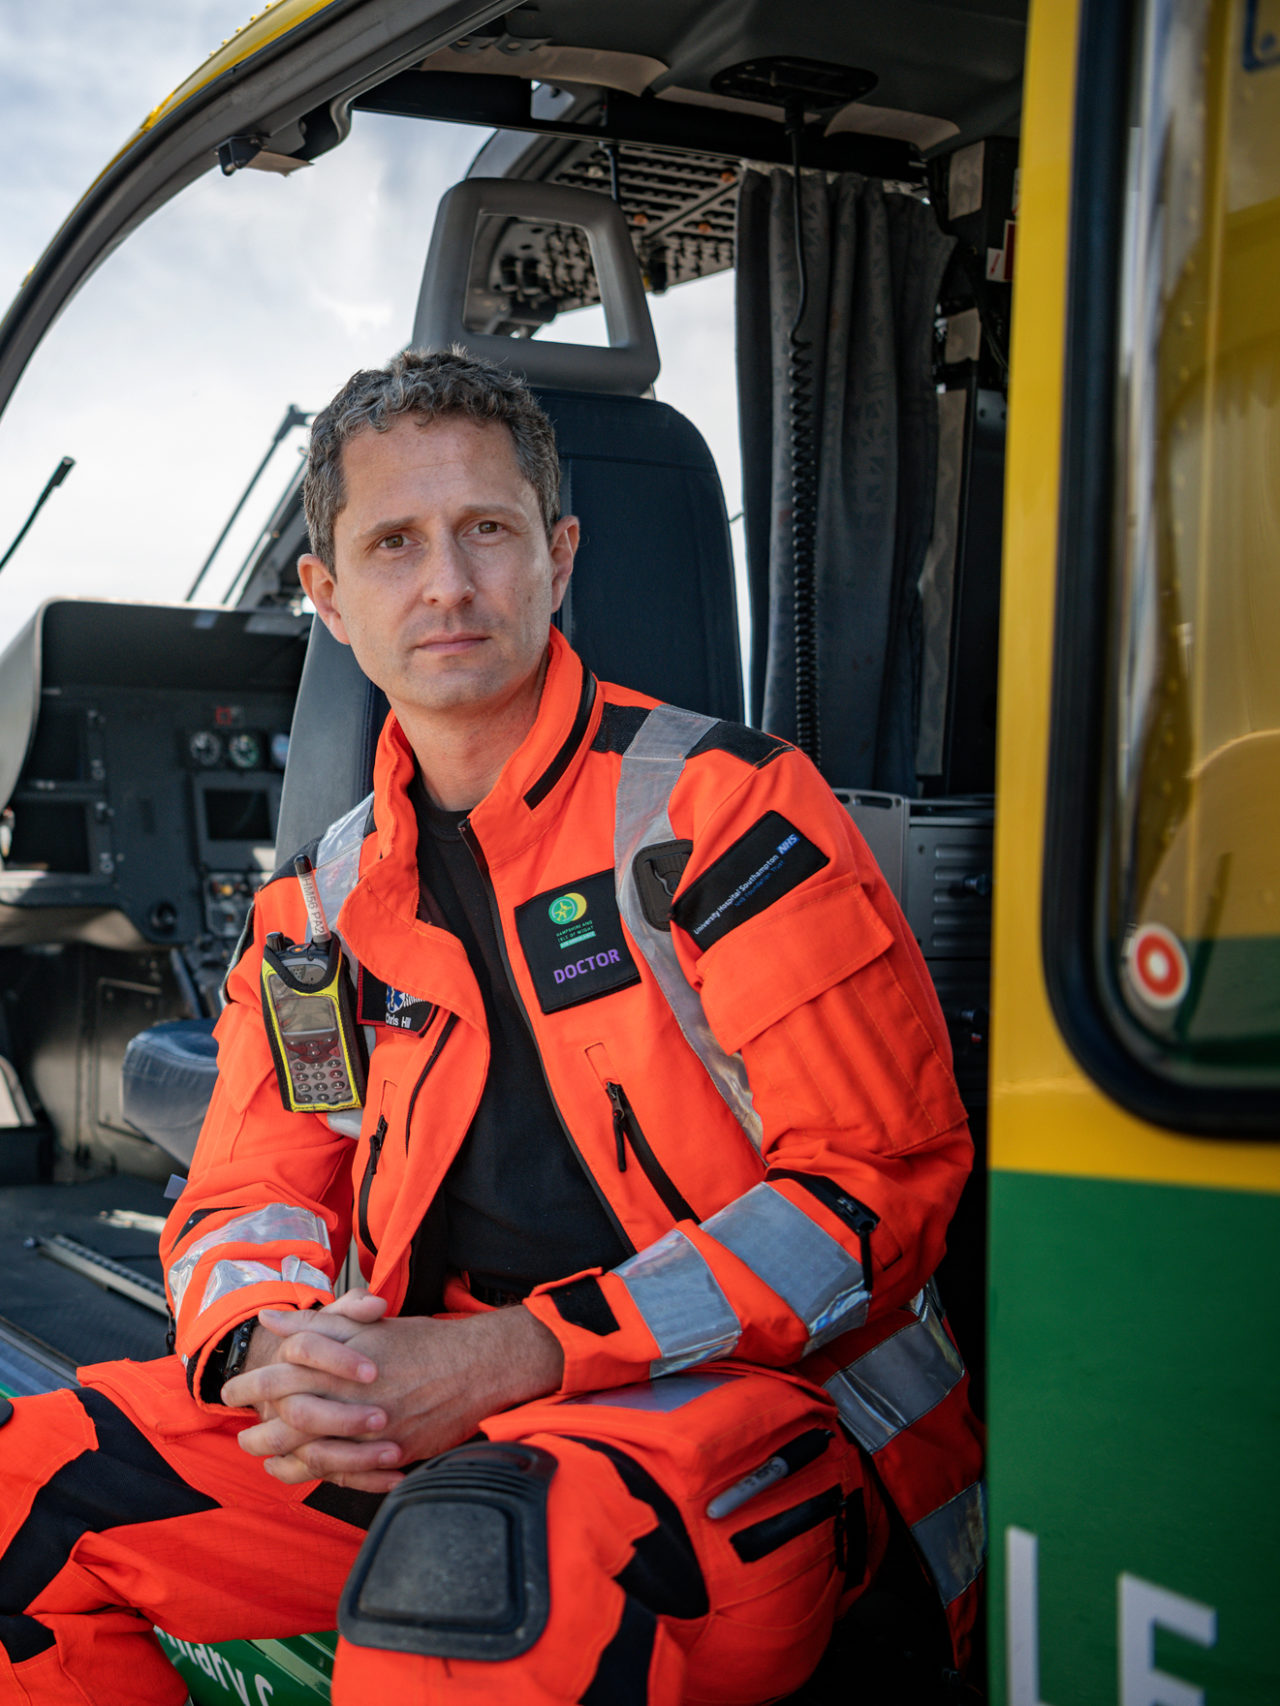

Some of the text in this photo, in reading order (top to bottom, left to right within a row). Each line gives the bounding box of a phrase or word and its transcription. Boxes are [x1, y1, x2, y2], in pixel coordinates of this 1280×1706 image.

[777, 834, 799, 855] NHS
[303, 877, 326, 934] HM56 PA2
[693, 855, 779, 935] University Hospital Southampton
[553, 948, 621, 984] DOCTOR
[385, 1012, 412, 1028] Chris Hill
